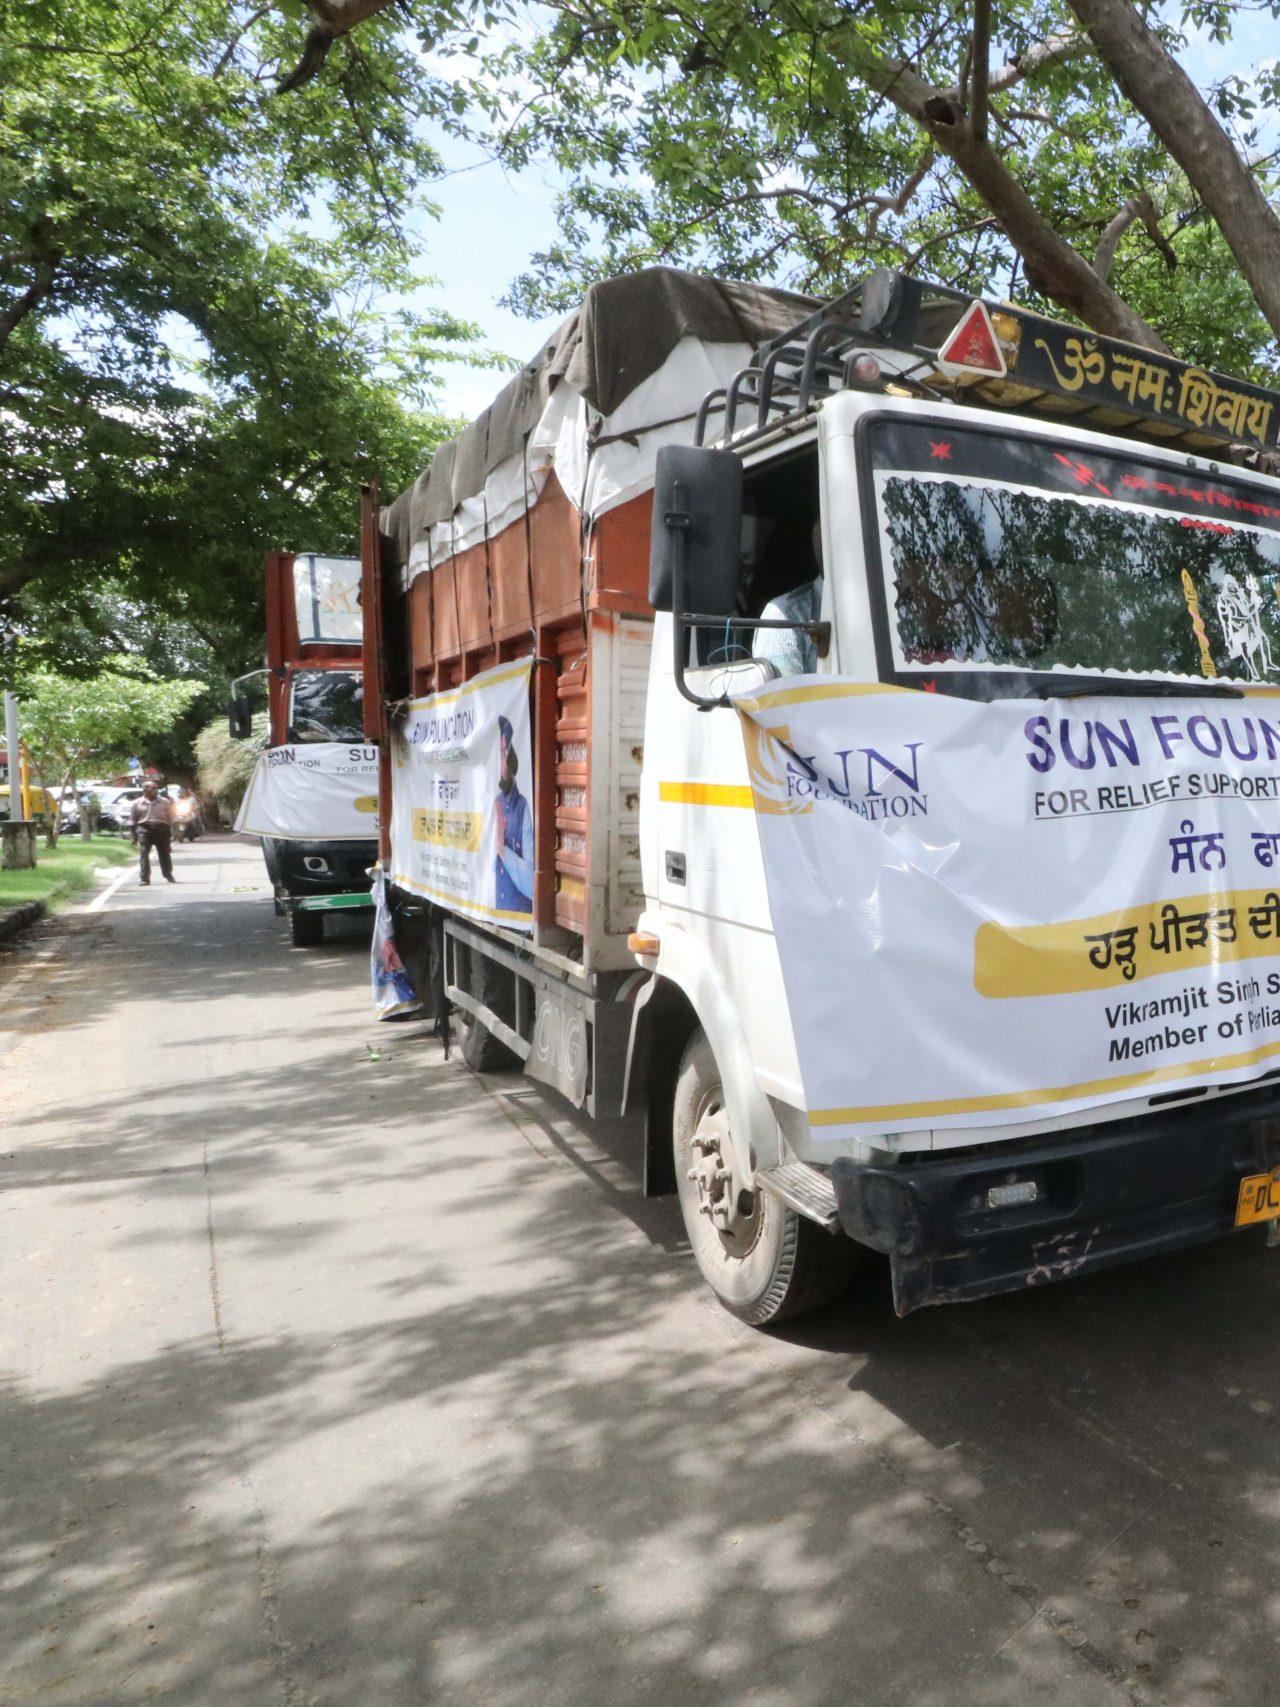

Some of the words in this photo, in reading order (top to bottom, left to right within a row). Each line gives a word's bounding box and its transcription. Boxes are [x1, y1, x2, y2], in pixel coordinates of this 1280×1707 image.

[1024, 715, 1140, 773] SUN
[1035, 788, 1091, 816] FOR
[1097, 775, 1180, 810] RELIEF
[1169, 819, 1226, 874] ਸੰਨ
[1105, 985, 1209, 1029] Vikramjit
[1109, 1024, 1208, 1062] Member
[1217, 1013, 1243, 1039] of
